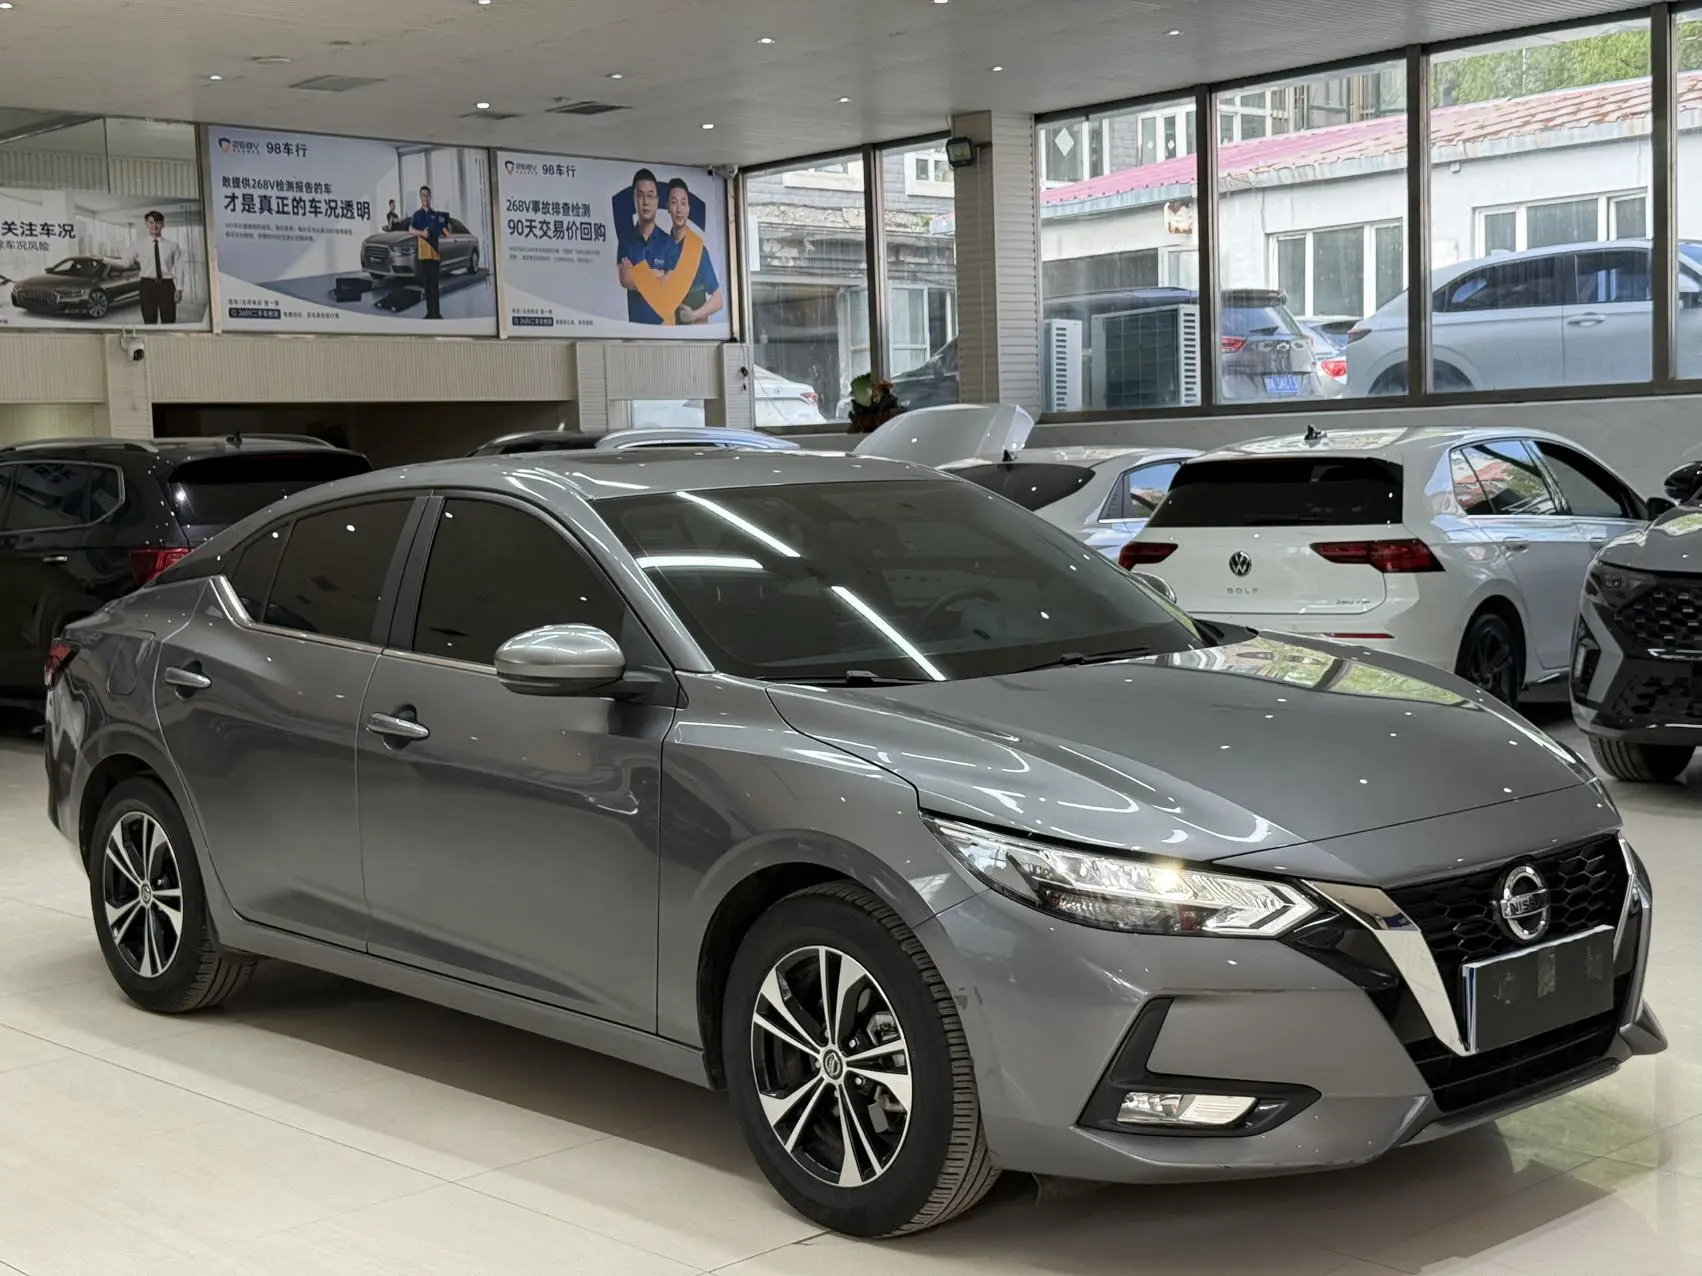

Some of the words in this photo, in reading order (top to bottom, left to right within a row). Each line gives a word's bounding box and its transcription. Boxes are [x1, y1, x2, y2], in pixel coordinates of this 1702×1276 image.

[266, 142, 307, 157] 98车行
[542, 164, 576, 178] 98车行
[222, 176, 332, 195] 敢提供268V检测报告的车
[224, 193, 370, 220] 才是真正的车况透明
[506, 199, 591, 217] 268V事故排查检测
[1, 221, 76, 239] 关注车况
[507, 219, 606, 242] 90天交易价回购
[1509, 892, 1546, 915] NISS
